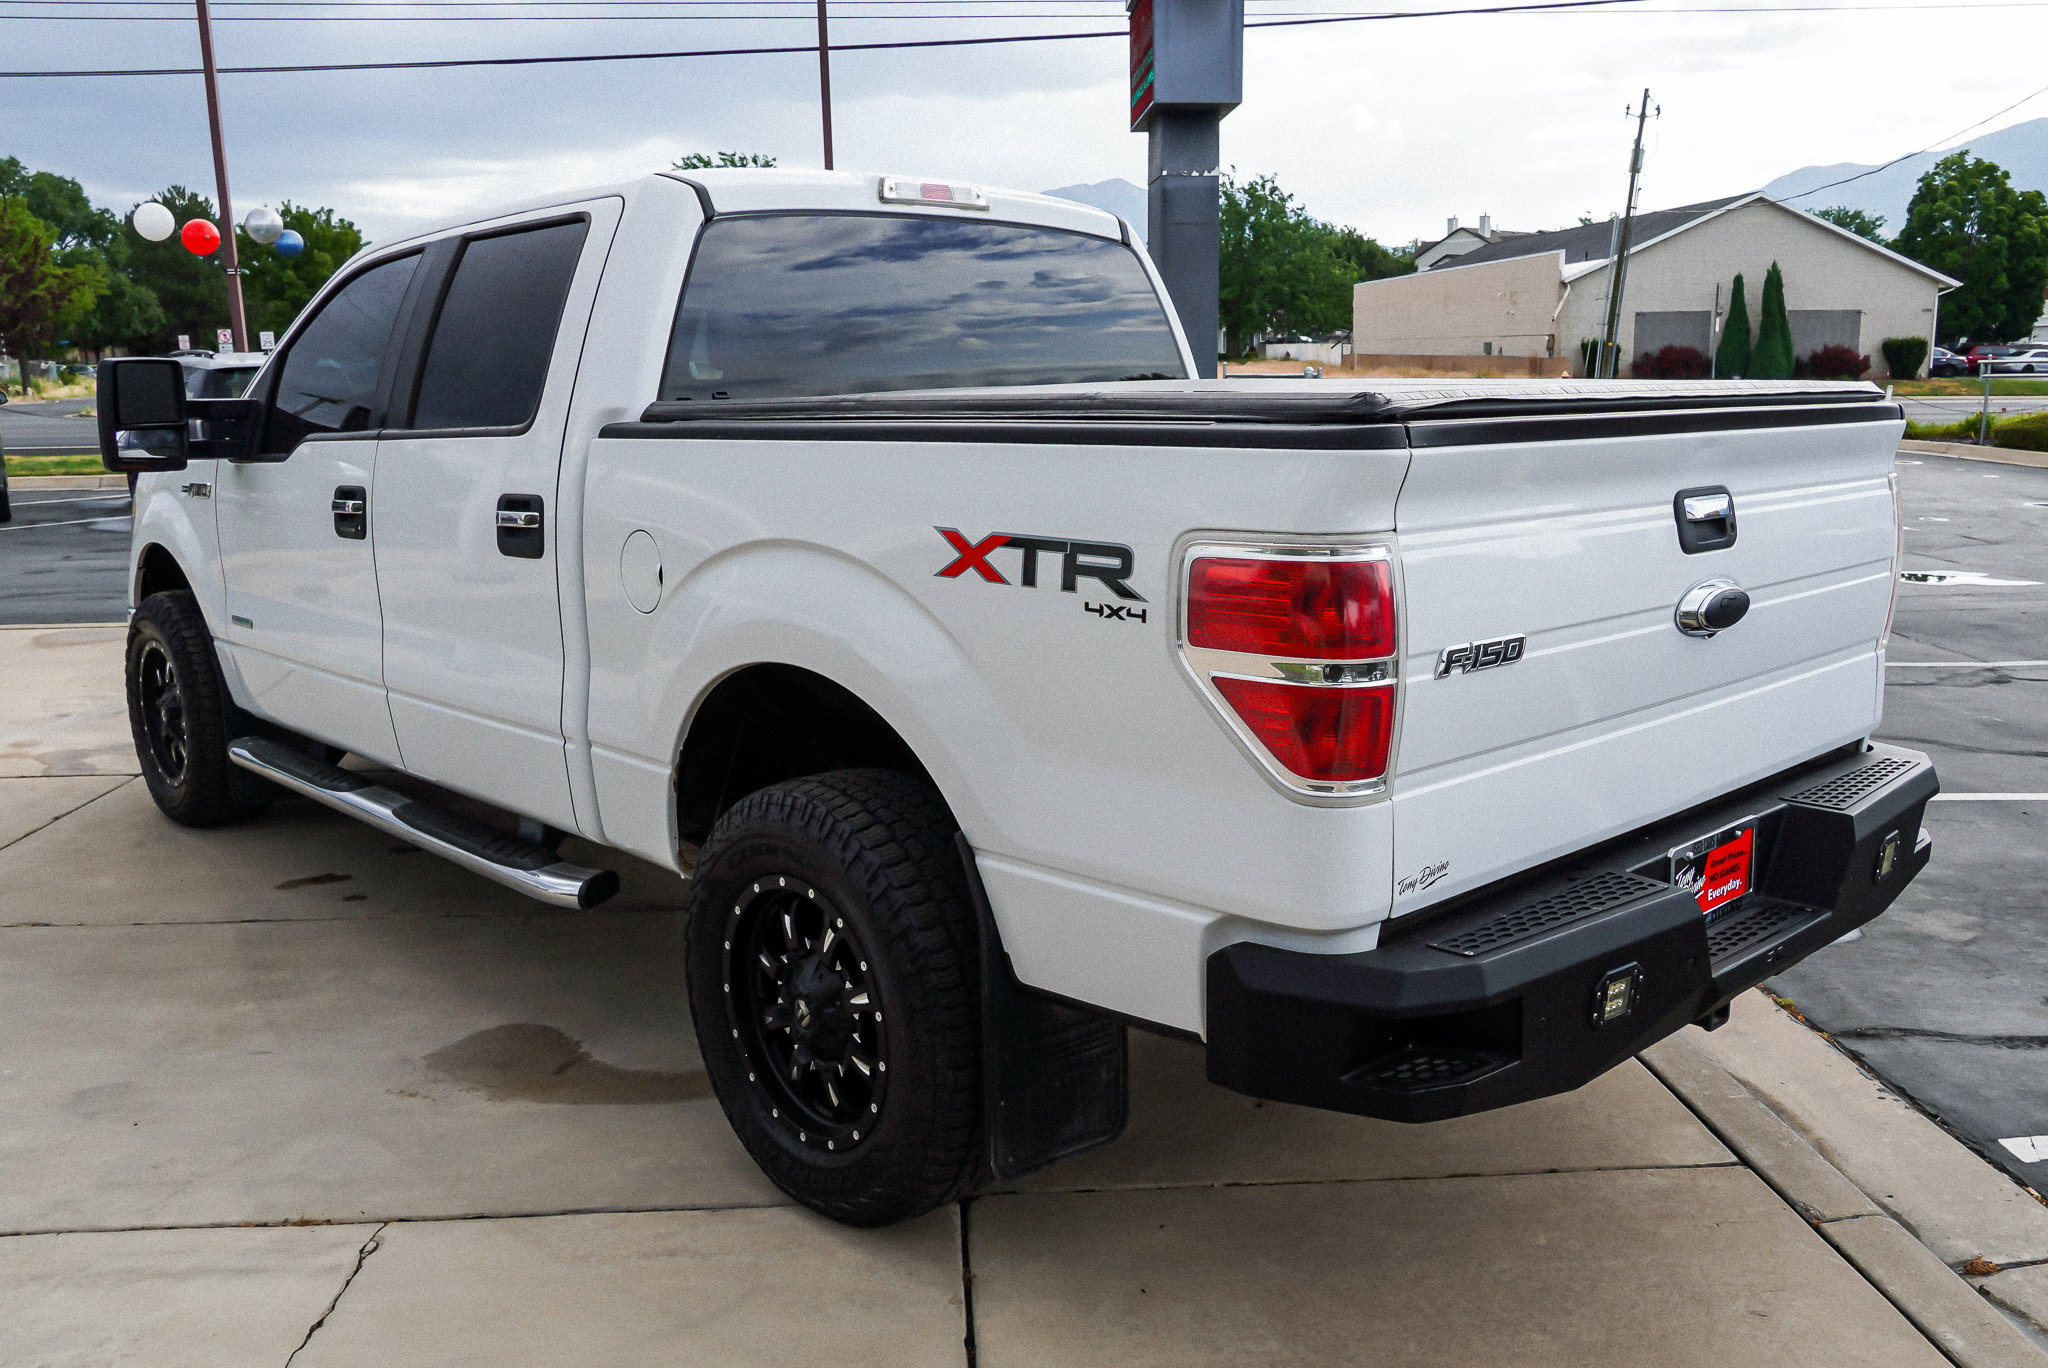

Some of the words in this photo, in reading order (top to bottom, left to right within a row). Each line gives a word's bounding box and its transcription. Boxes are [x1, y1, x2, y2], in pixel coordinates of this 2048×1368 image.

[932, 525, 1149, 603] XTR
[1434, 633, 1526, 680] F-150
[1397, 874, 1418, 896] Tony
[1419, 860, 1450, 885] Divino
[1676, 864, 1695, 888] Tony
[1707, 878, 1743, 901] Everyday.
[1708, 871, 1719, 883] NO
